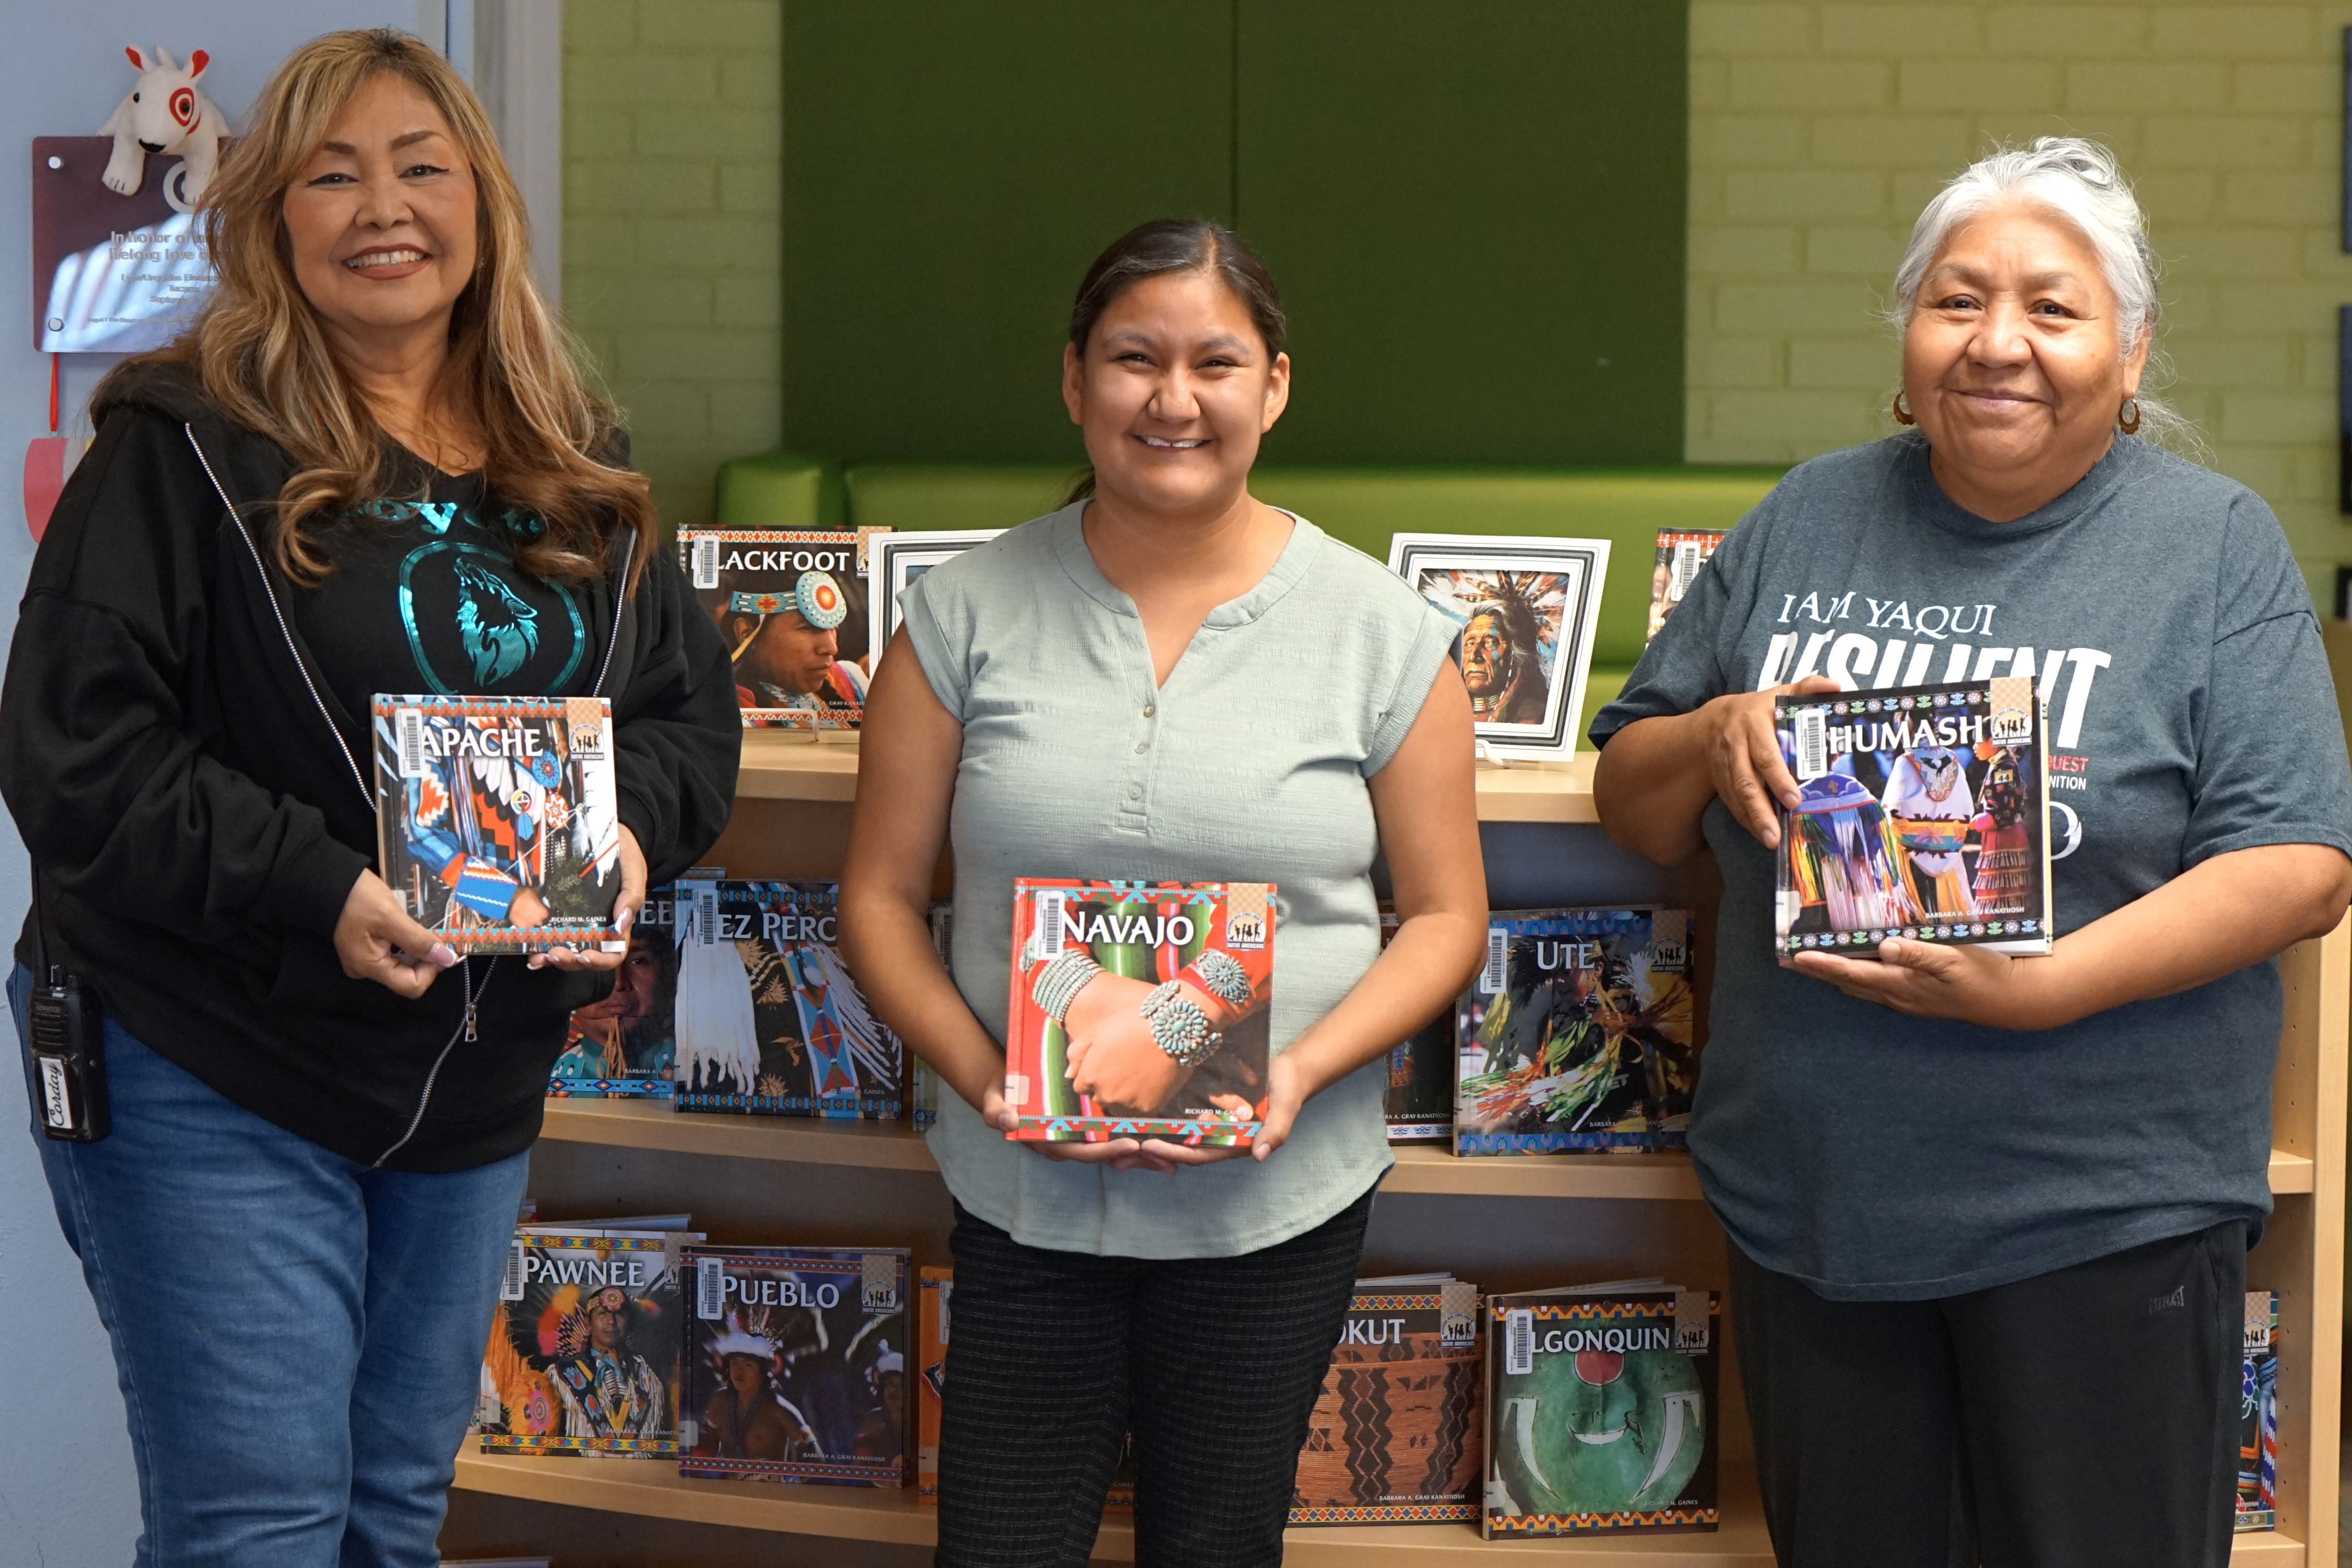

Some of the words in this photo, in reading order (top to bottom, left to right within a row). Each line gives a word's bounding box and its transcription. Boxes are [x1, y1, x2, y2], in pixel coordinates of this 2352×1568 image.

[111, 230, 125, 243] In
[128, 231, 170, 243] honor
[109, 248, 160, 262] lifelong
[165, 249, 194, 260] love
[691, 551, 850, 572] ACKFOOT
[1865, 598, 1997, 640] YAQUI
[421, 726, 543, 758] APACHE
[1825, 715, 1984, 754] HUMASH
[717, 914, 752, 939] EZ
[763, 912, 837, 942] PERC
[1062, 911, 1194, 949] NAVAJO
[1537, 941, 1595, 970] UTE
[524, 1256, 645, 1287] PAWNEE
[722, 1276, 840, 1309] PUEBLO
[1532, 1327, 1670, 1354] LGONQUIN
